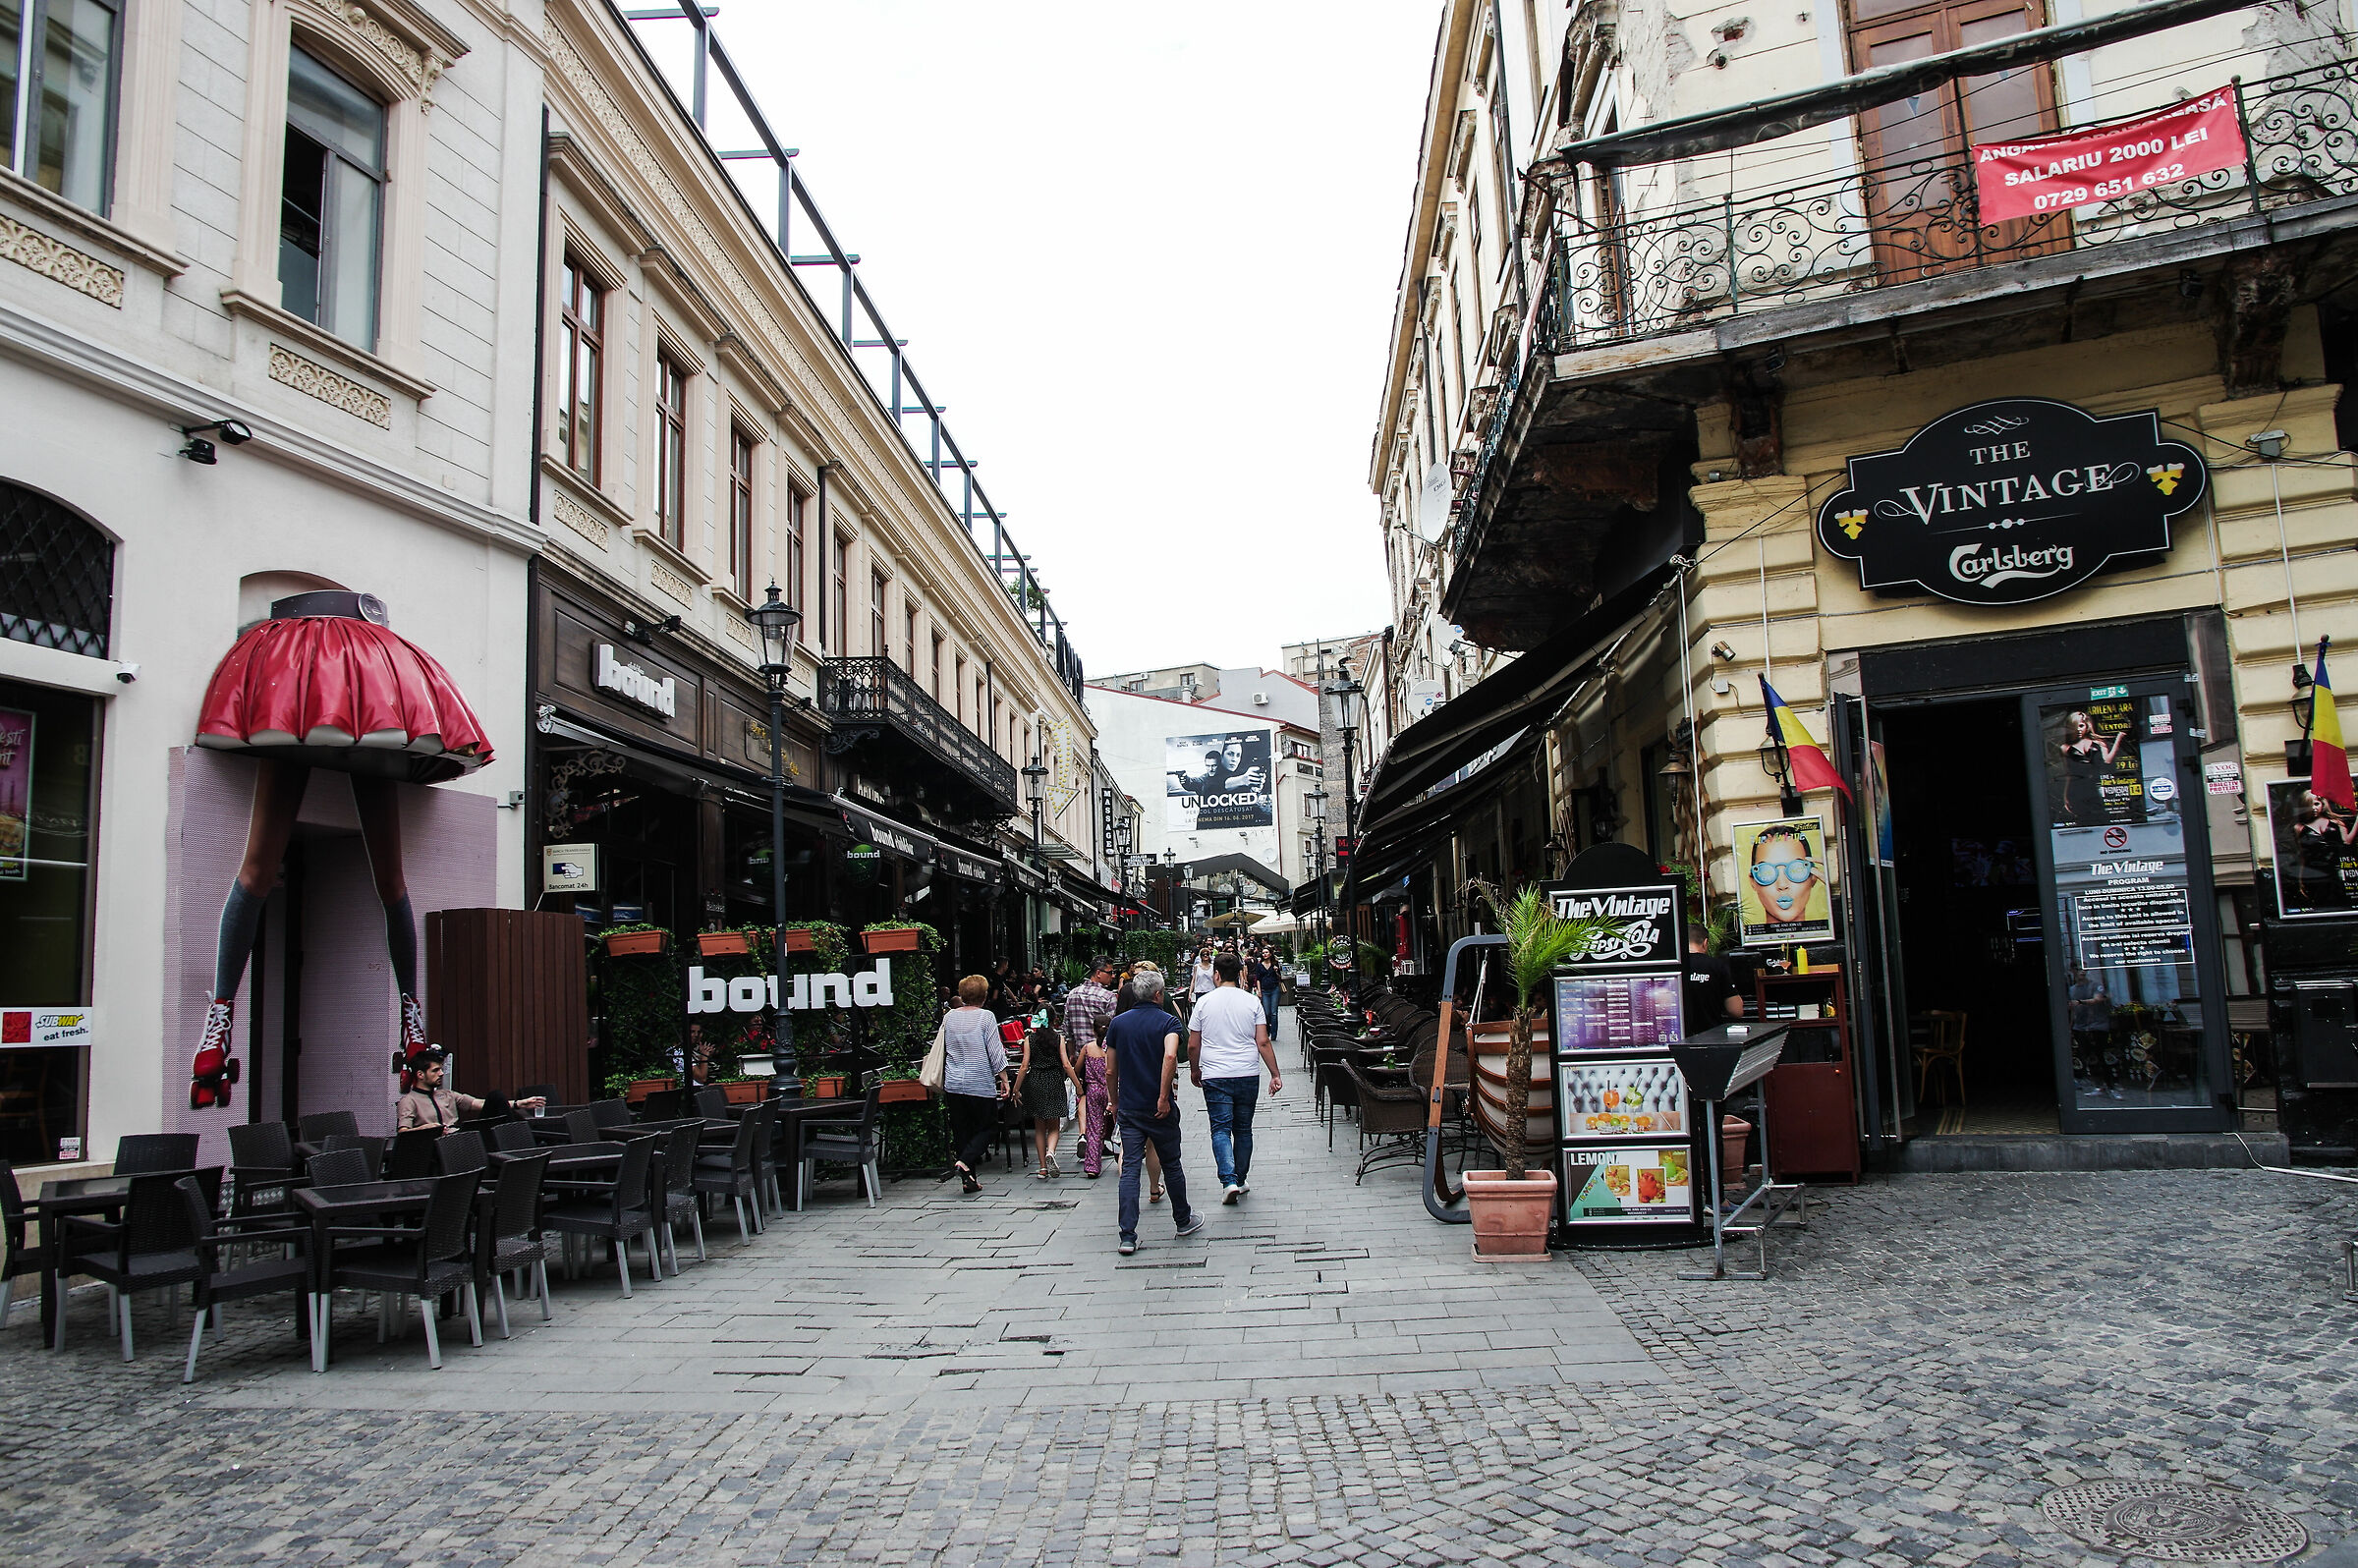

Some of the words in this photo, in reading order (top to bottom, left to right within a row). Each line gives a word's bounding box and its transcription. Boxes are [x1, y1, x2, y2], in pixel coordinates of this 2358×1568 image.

[1980, 140, 2072, 163] ANGA
[2004, 151, 2103, 187] SALARIU
[2109, 139, 2164, 163] 2000
[2170, 127, 2209, 151] LEI
[2034, 187, 2088, 210] 0729
[2094, 178, 2134, 198] 651
[2142, 163, 2185, 186] 632
[1969, 441, 2031, 465] THE
[1899, 464, 2113, 526] VINTAGE
[1949, 542, 2074, 586] Carlsberg
[598, 644, 676, 718] bound
[1182, 792, 1258, 809] UNLOCKED
[1103, 790, 1113, 848] MASSAGE
[869, 821, 895, 849] bound
[846, 850, 880, 859] bound
[688, 958, 894, 1014] bound
[35, 1014, 84, 1029] SUBWAY
[43, 1032, 60, 1041] eat
[62, 1028, 88, 1037] fresh.
[2173, 1525, 2256, 1547] BUCURESTI
